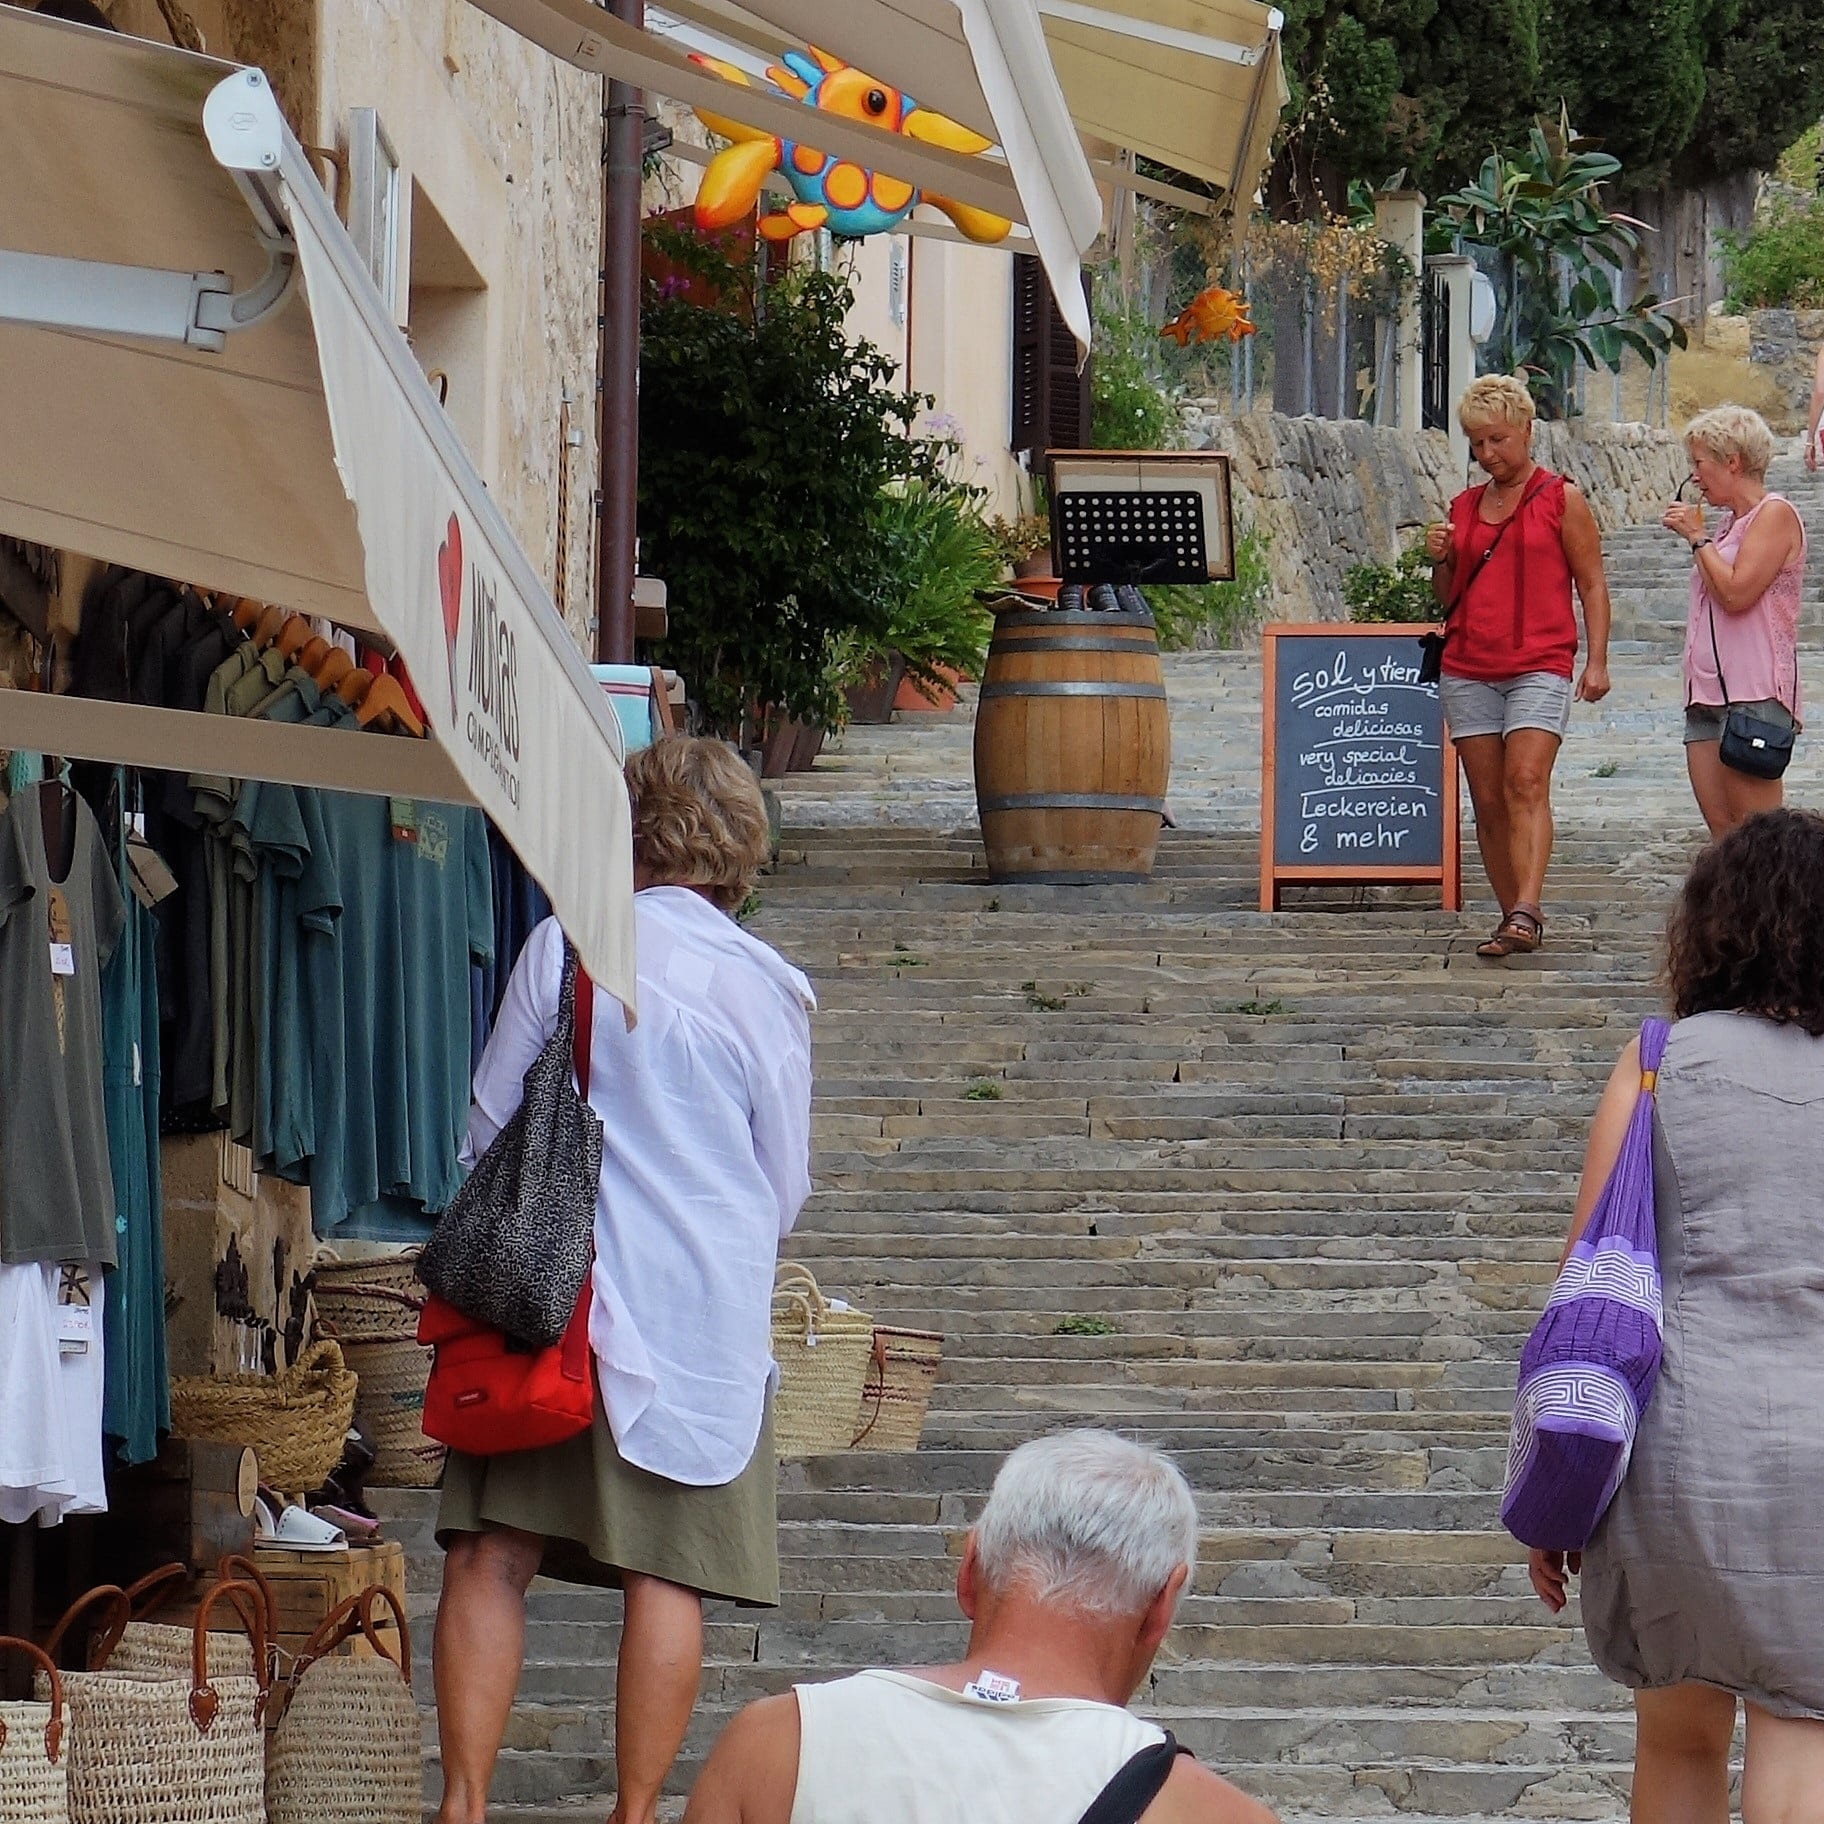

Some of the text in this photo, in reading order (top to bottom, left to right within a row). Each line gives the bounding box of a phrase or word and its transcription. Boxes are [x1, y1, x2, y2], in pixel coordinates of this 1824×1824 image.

[1291, 651, 1439, 702] Sol y tien
[1314, 698, 1389, 717] comidas
[1332, 719, 1423, 737] deliciosas
[1300, 745, 1417, 772] very special
[1324, 767, 1416, 786] delicacies
[1301, 796, 1428, 819] Leckereien
[1300, 823, 1410, 852] & mehr
